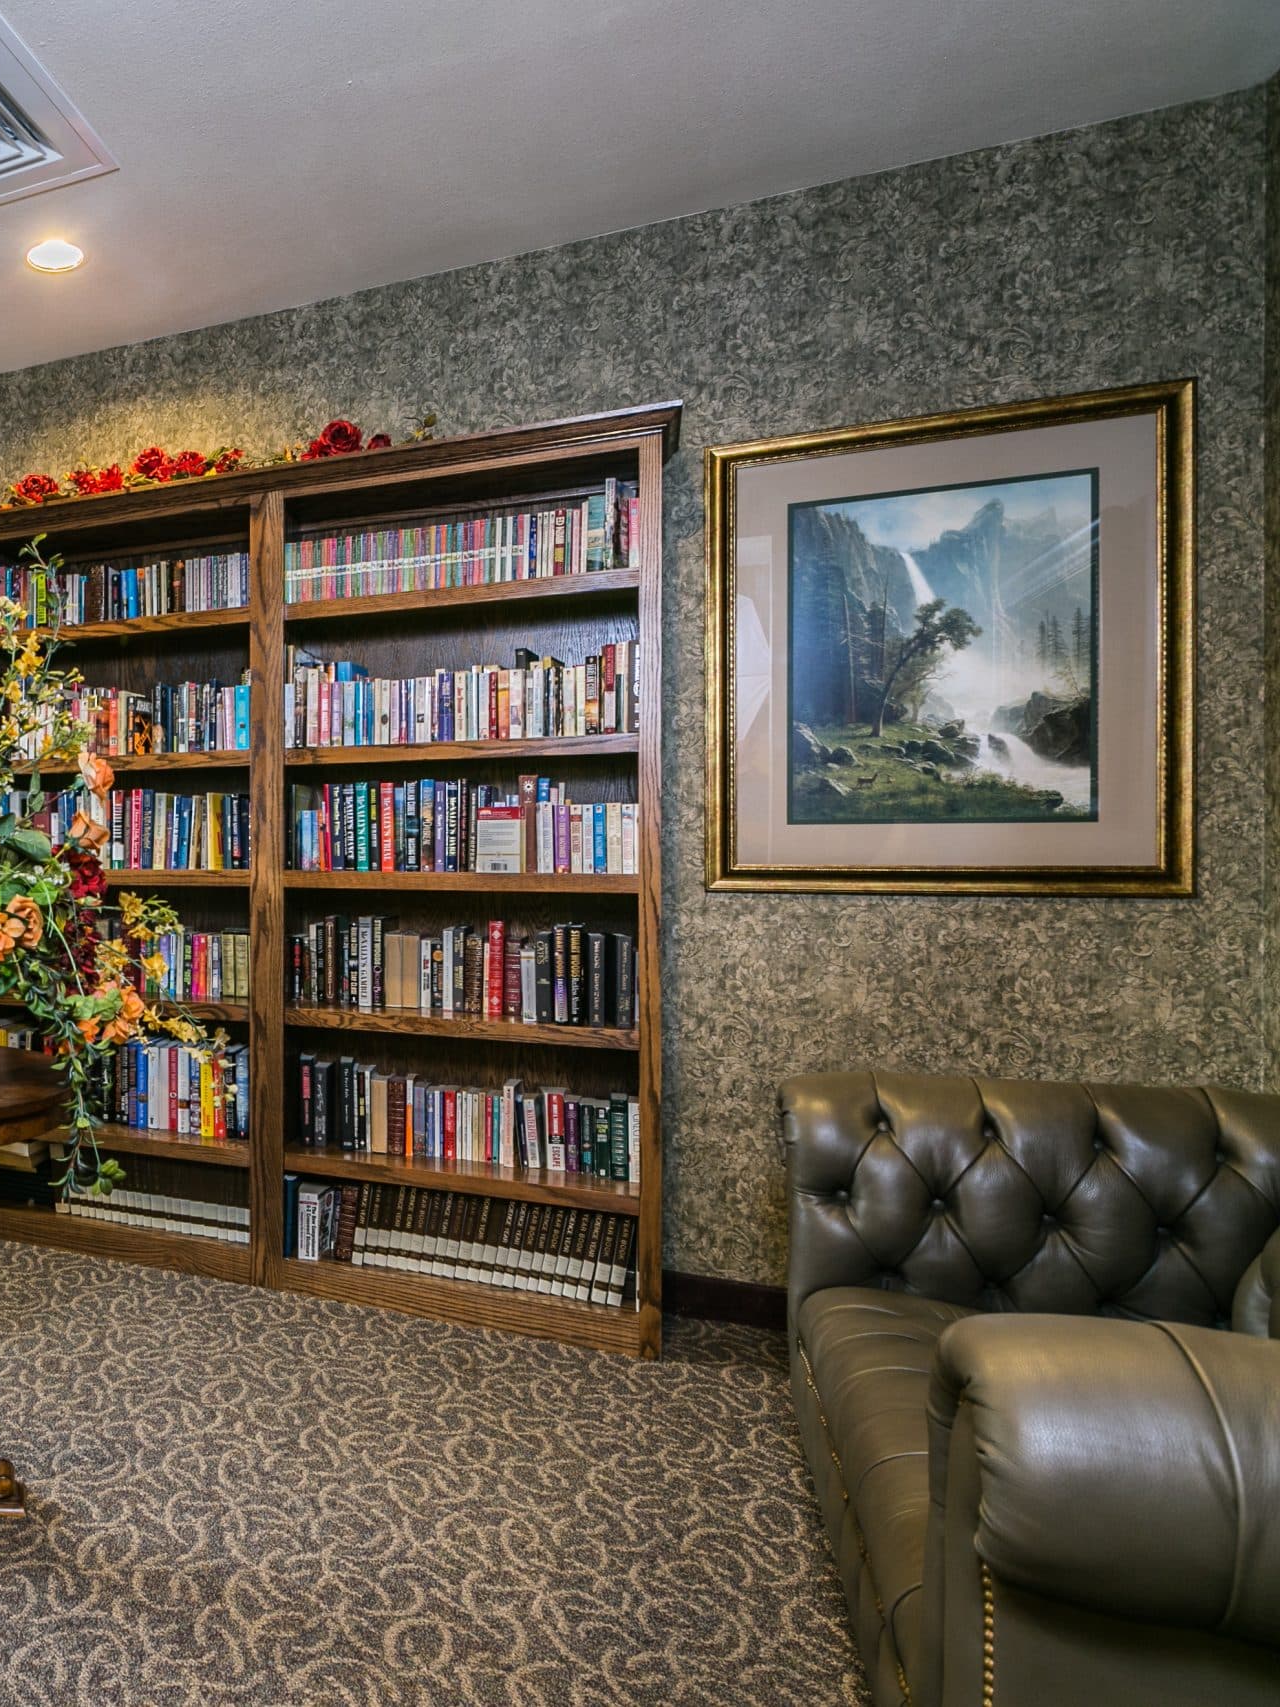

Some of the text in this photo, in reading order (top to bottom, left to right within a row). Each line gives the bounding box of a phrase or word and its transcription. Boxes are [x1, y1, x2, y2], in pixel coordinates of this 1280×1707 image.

[357, 836, 367, 861] CAPER
[383, 838, 392, 861] TRIAL
[536, 941, 545, 965] CATES
[570, 930, 580, 977] STUART WOODS
[360, 970, 368, 999] GAMBLE
[552, 1146, 561, 1168] ESCAPE
[478, 1224, 486, 1240] YEAR
[502, 1201, 515, 1244] SCIENCE YEAR
[514, 1203, 527, 1245] SCIENCE YEAR
[527, 1207, 539, 1246] YEAR BOOK
[539, 1233, 547, 1249] YEAR
[551, 1210, 563, 1249] YEAR BOOK
[564, 1209, 577, 1253] SCIENCE YEAR
[576, 1213, 589, 1253] YEAR BOOK
[588, 1214, 603, 1258] SCIENCE YEAR
[603, 1217, 616, 1257] YEAR BOOK
[618, 1219, 631, 1260] YEAR BOOK
